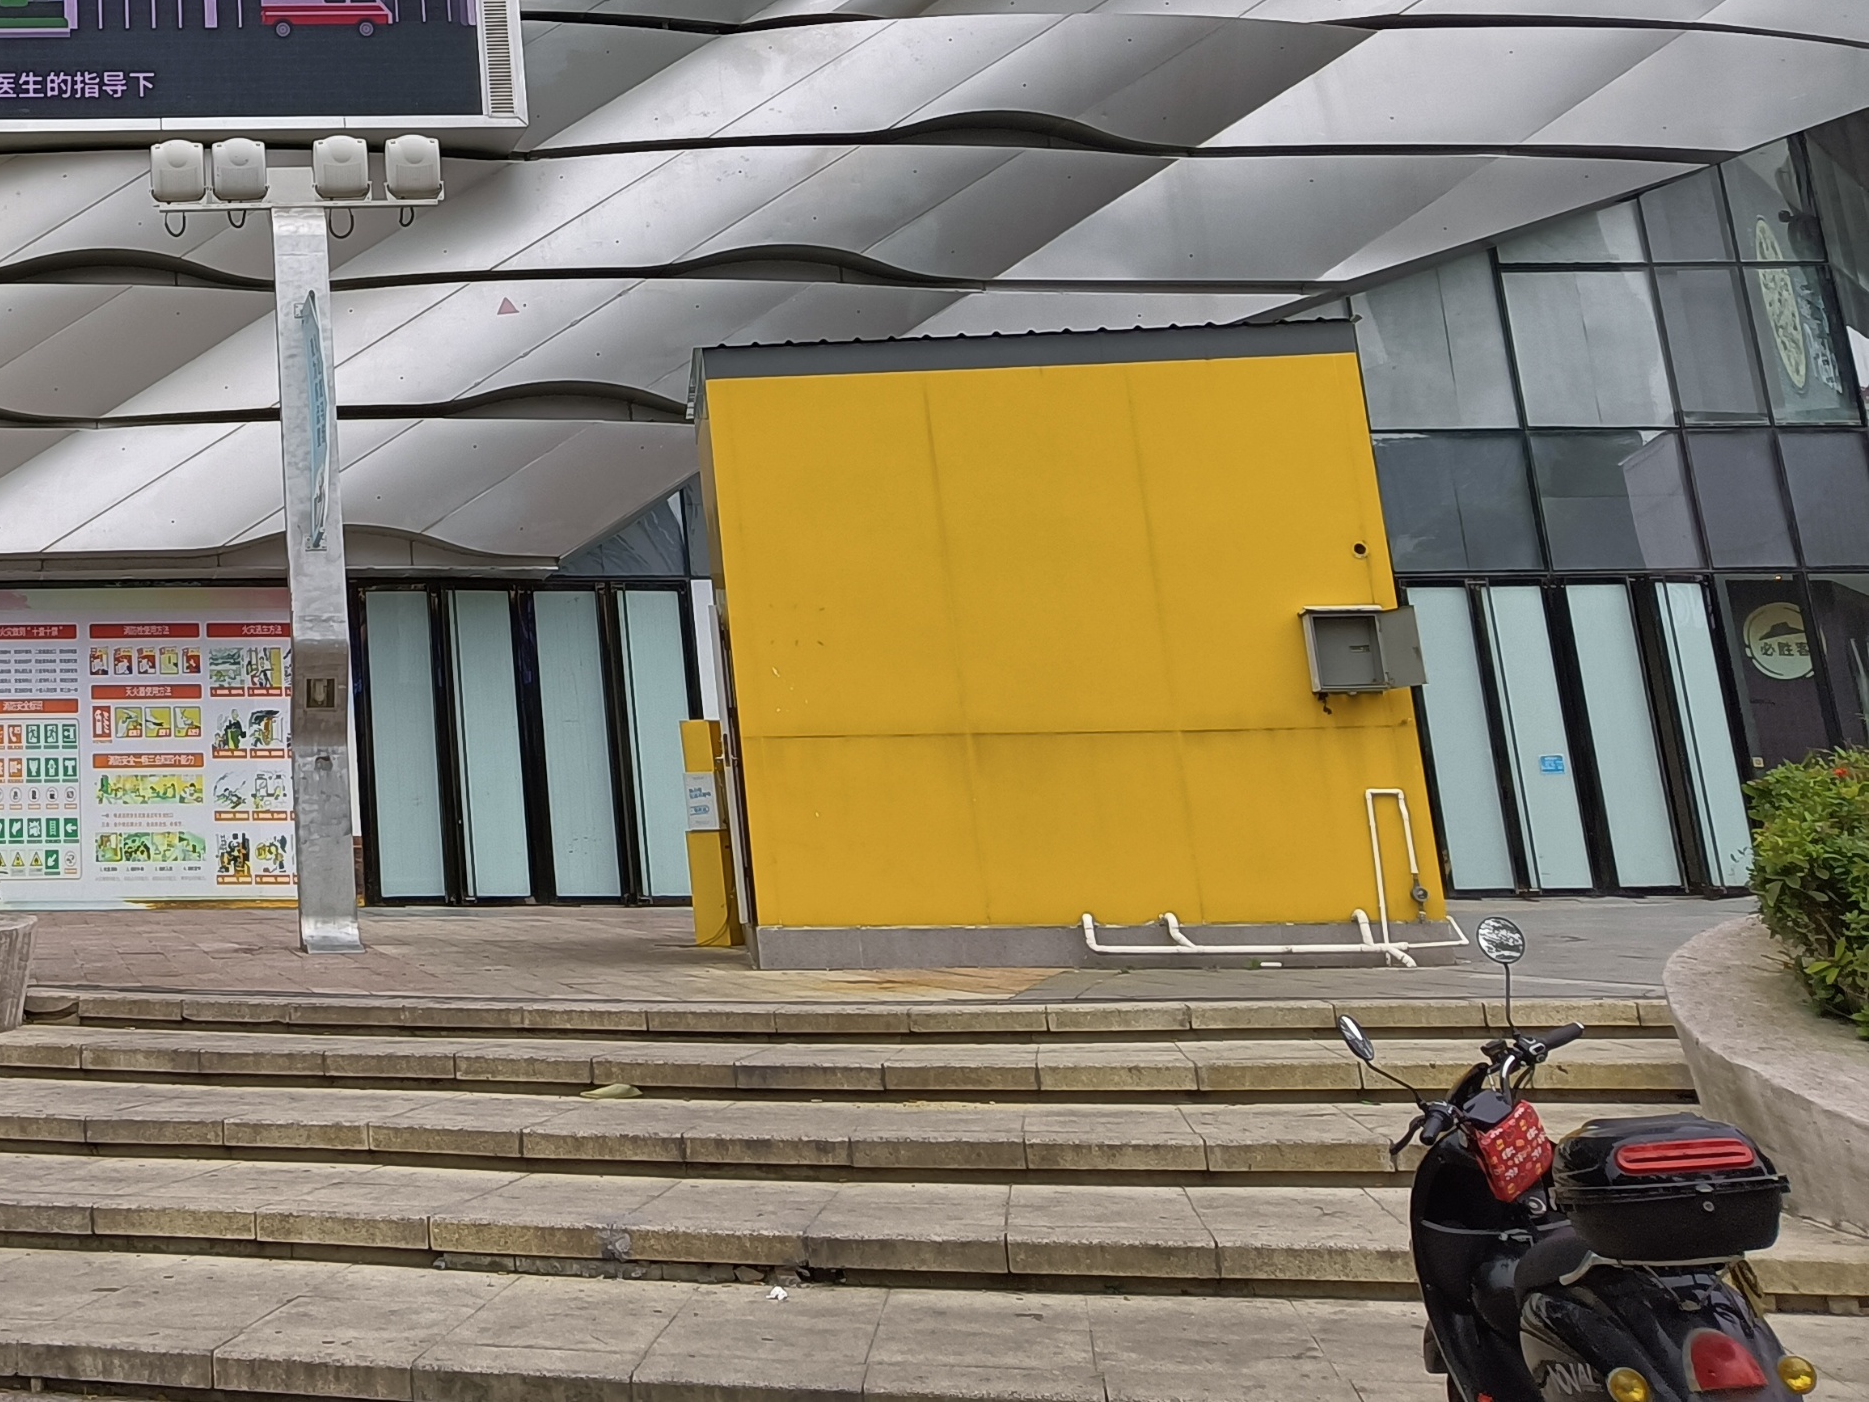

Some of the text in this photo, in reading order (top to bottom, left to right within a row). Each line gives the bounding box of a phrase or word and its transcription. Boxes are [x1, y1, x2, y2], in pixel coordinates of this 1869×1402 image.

[1760, 642, 1810, 657] 必胜客
[125, 686, 172, 697] 灭火器使用方法
